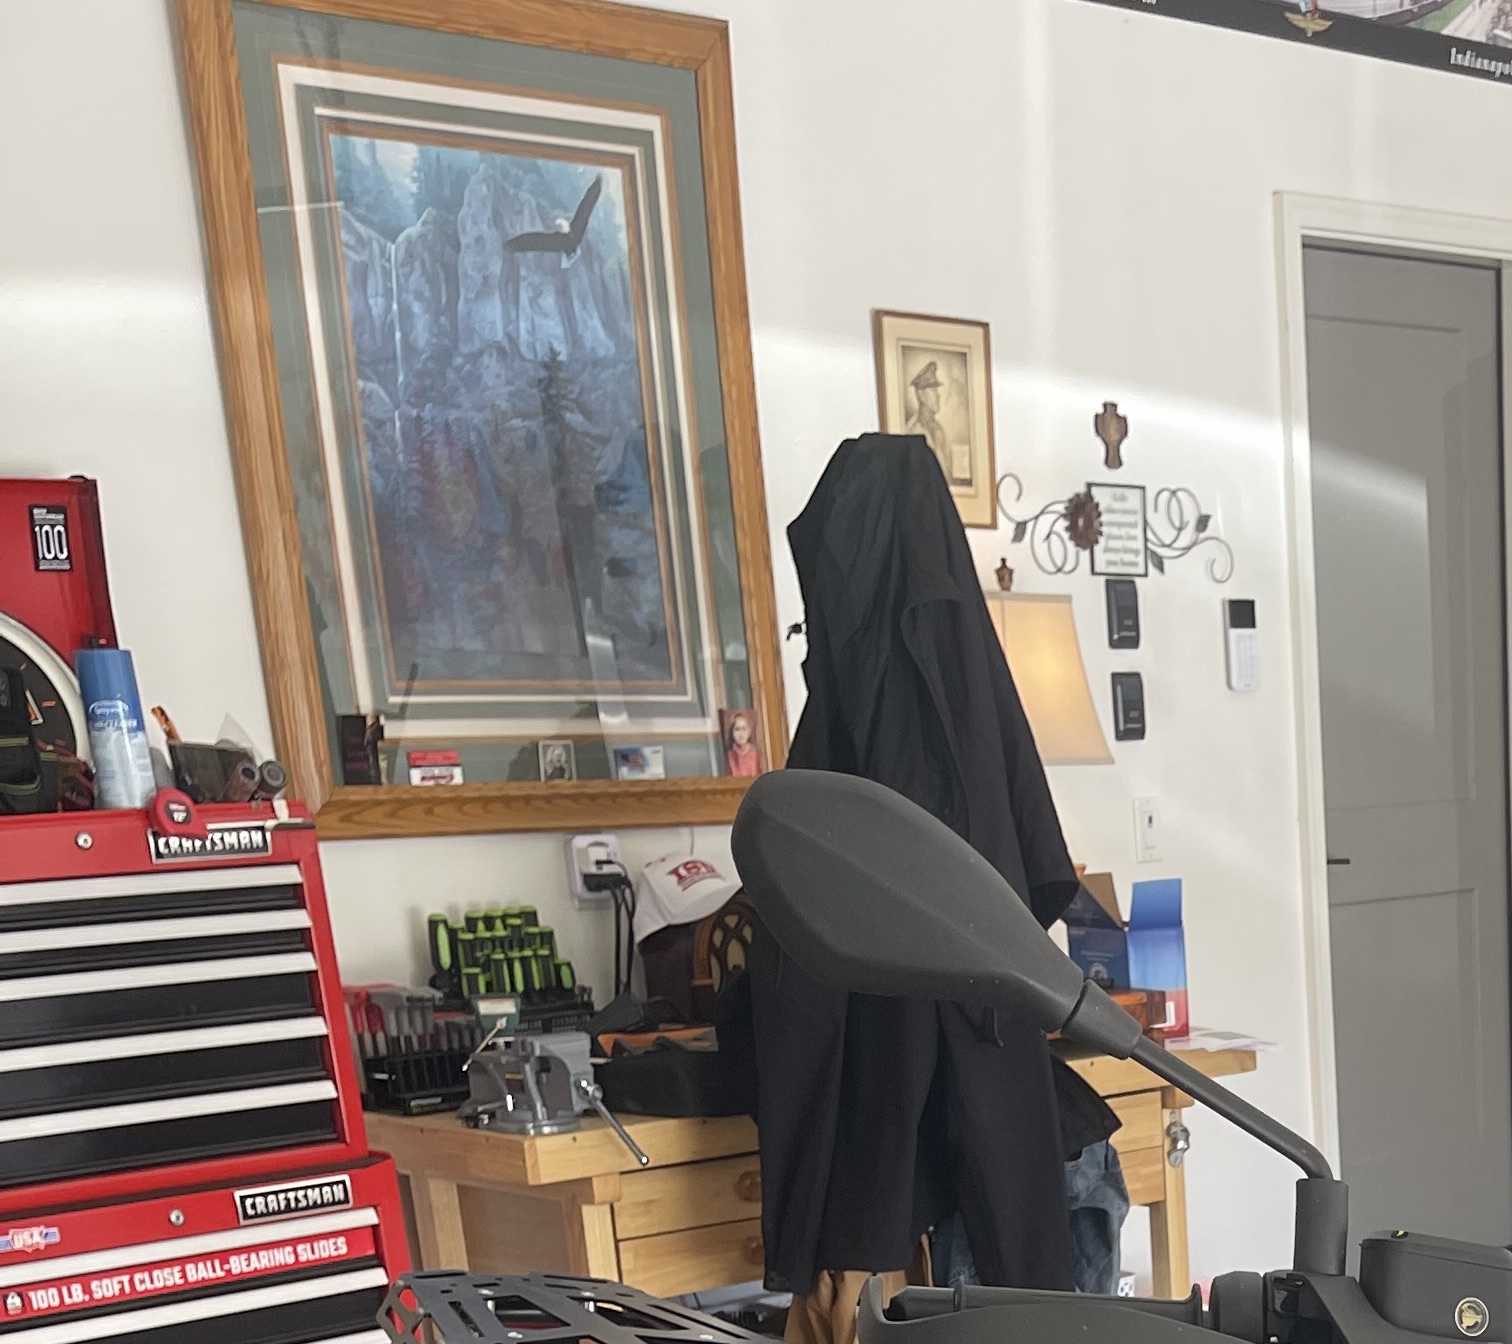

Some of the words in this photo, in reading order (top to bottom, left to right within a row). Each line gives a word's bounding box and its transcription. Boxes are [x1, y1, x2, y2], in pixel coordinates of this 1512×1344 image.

[34, 525, 69, 560] 100
[245, 1183, 345, 1216] CRAFTSMAN
[13, 1231, 42, 1249] USA
[28, 1286, 60, 1311] 100
[61, 1282, 90, 1306] LB.
[90, 1274, 131, 1299] SOFT
[133, 1265, 185, 1291] CLOSE
[184, 1245, 296, 1284] BALL-BEARING
[296, 1236, 348, 1262] SLIDES
